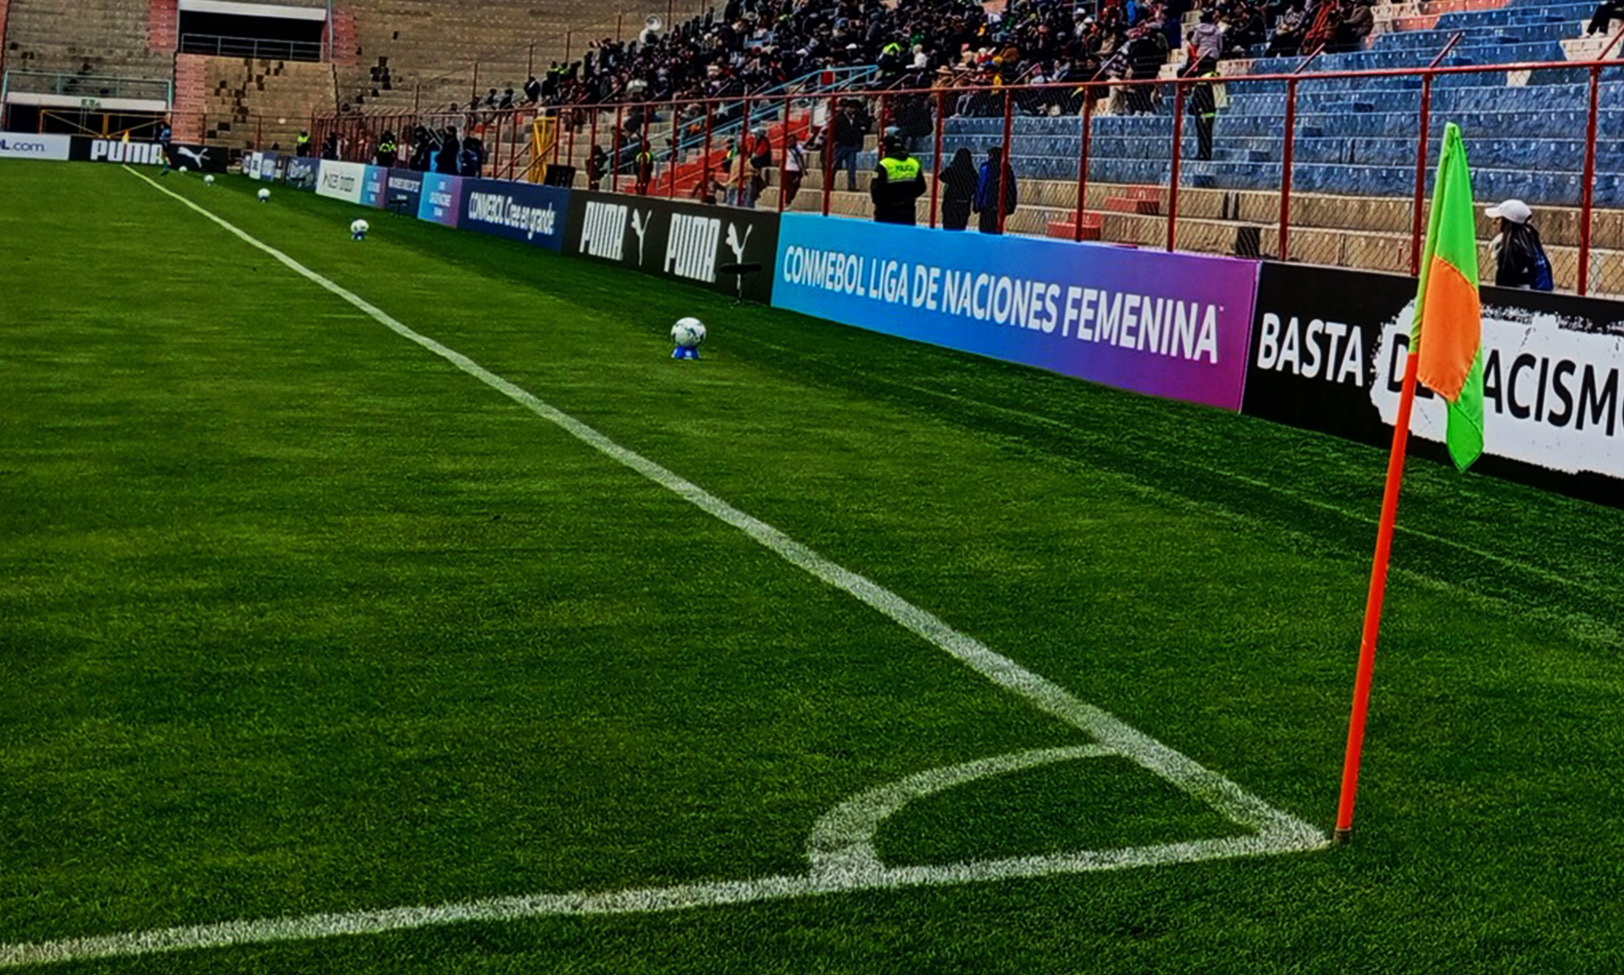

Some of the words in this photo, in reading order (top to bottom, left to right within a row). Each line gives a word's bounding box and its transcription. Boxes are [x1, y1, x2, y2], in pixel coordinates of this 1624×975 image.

[90, 139, 164, 165] PUMA
[579, 200, 628, 261] PUMA
[664, 212, 722, 283] PUMA
[783, 244, 865, 297] CONMEBOL
[869, 257, 908, 306] LIGA
[911, 264, 941, 311] DE
[942, 269, 1061, 334] NACIONES
[1062, 285, 1218, 365] FEMENINA
[1256, 311, 1364, 388] BASTA
[1387, 332, 1435, 400] D
